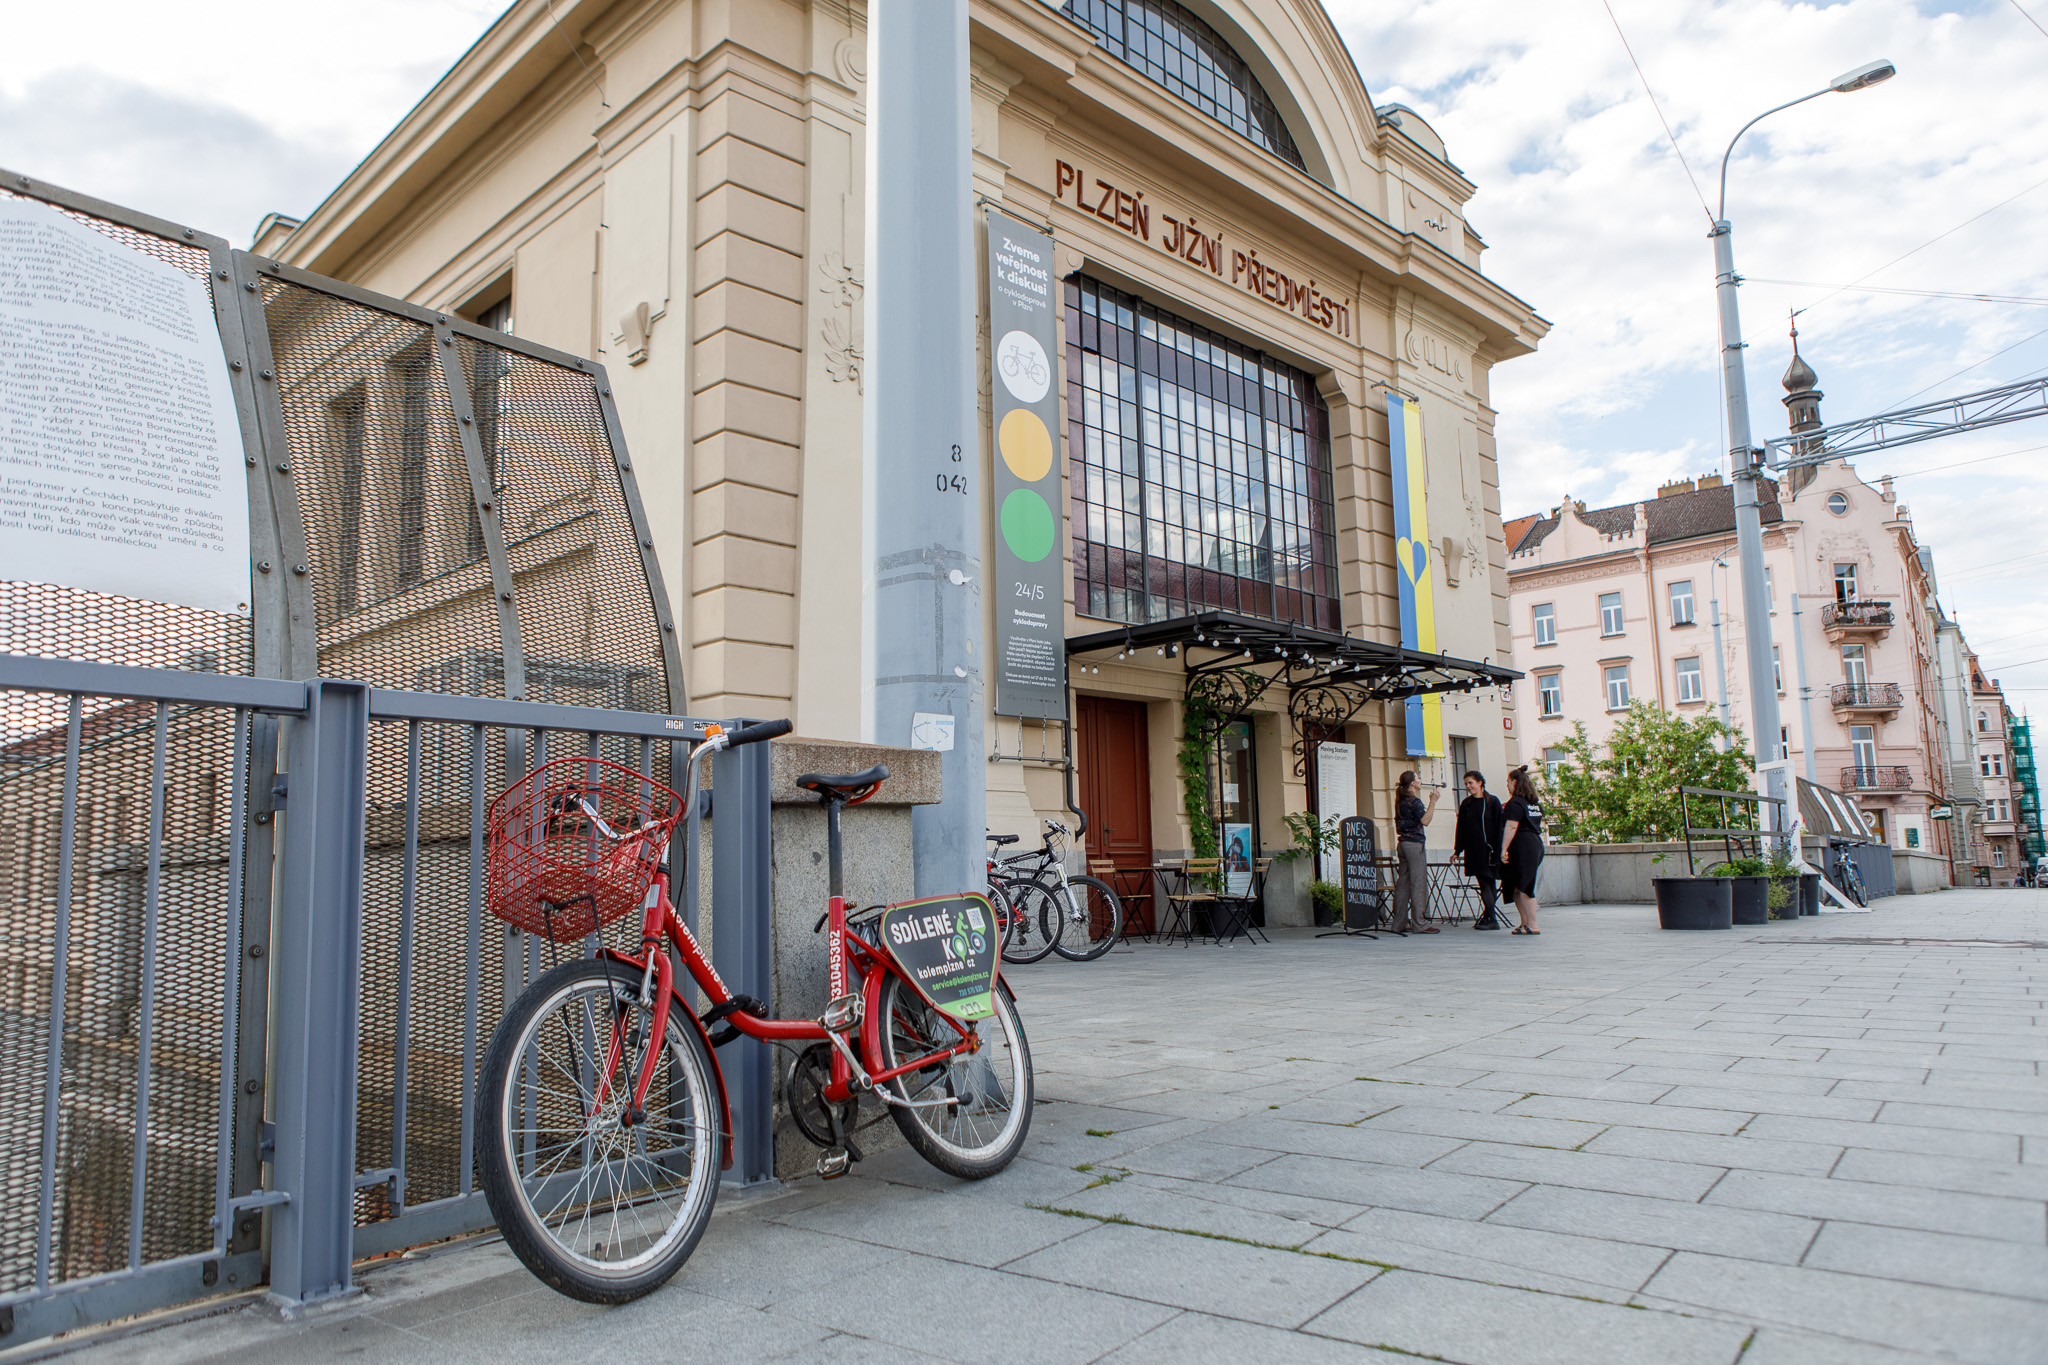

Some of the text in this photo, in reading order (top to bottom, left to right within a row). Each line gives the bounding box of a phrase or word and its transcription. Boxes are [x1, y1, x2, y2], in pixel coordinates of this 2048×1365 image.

[1003, 237, 1040, 263] Zveme
[1056, 159, 1350, 337] PLZEŇ JIŽNÍ PŘEDMĚSTÍ
[996, 252, 1048, 282] veřejnost
[998, 265, 1046, 296] k diskusi
[952, 444, 962, 462] 8
[936, 474, 968, 496] 042
[1014, 582, 1045, 600] 24/5
[665, 719, 684, 730] HIGH
[1346, 822, 1367, 837] DNES
[890, 908, 954, 944] SDÍLENÉ
